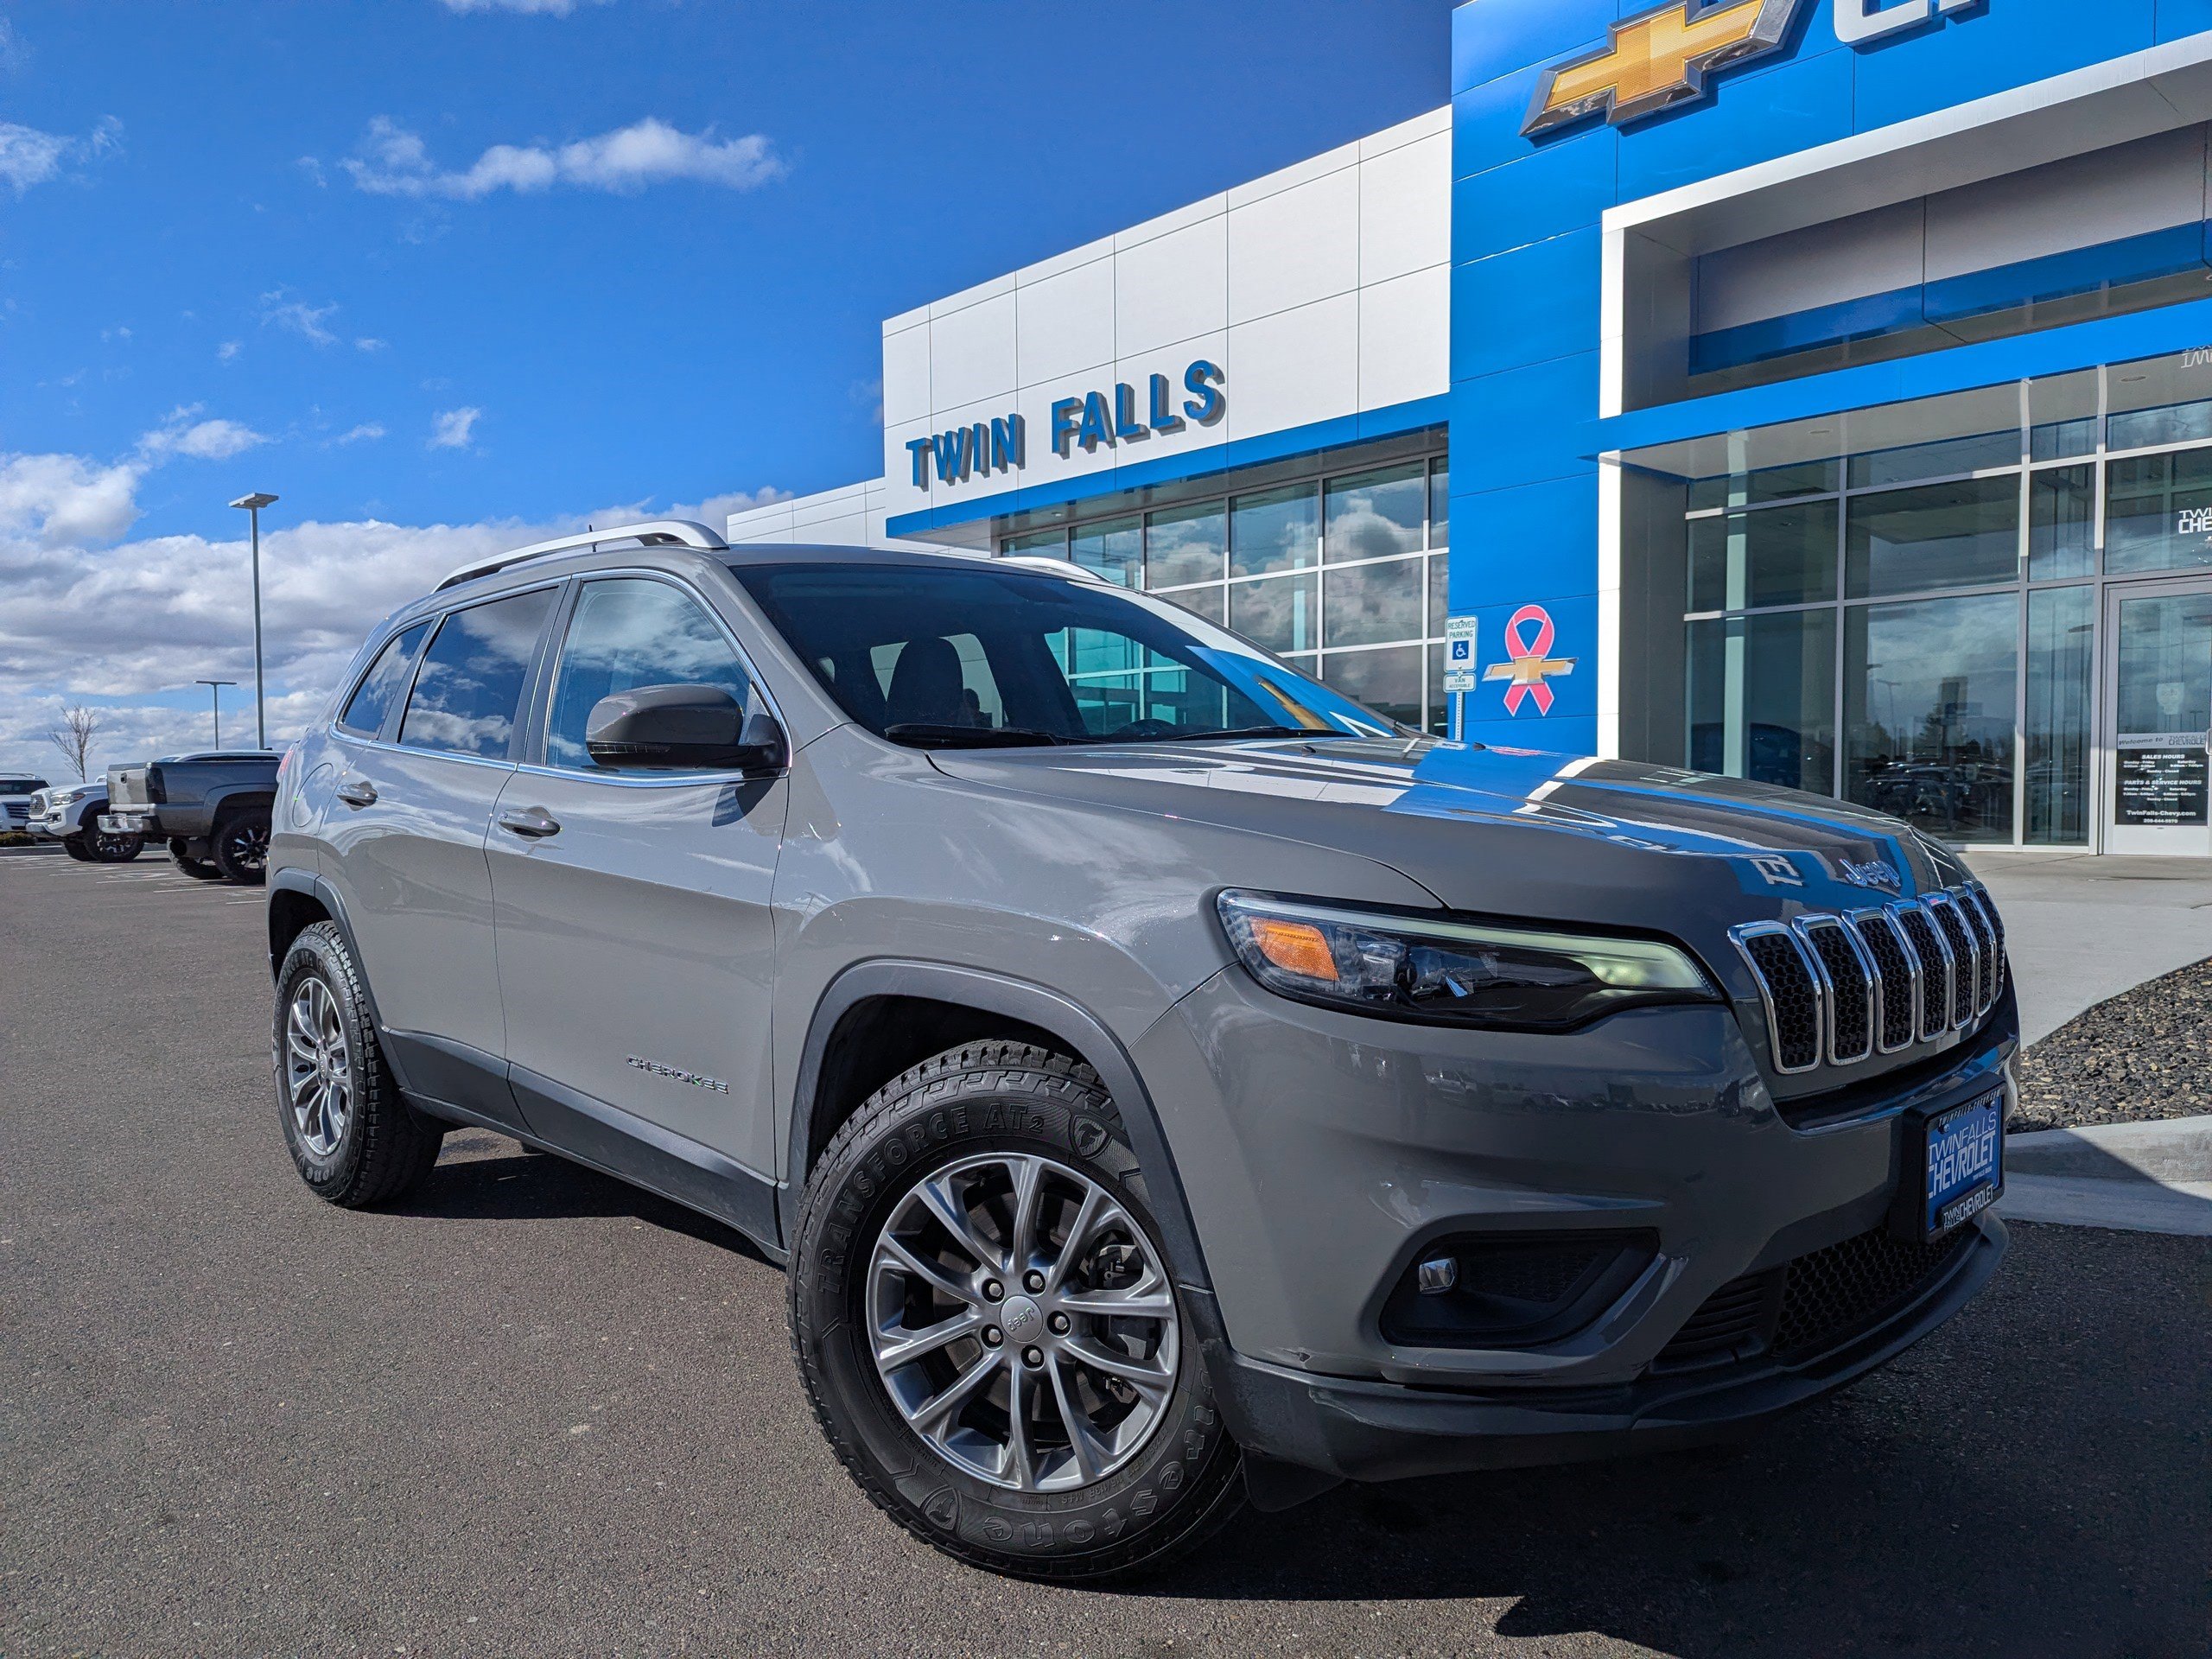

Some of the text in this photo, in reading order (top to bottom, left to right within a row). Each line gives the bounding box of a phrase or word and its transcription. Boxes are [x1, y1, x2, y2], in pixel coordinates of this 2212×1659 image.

[906, 359, 1226, 493] TWIN FALLS
[1447, 620, 1476, 630] RESERVED
[1839, 859, 1902, 887] Jeep
[626, 1054, 728, 1095] CHEROKEE
[1929, 1111, 1998, 1164] TWINFALLS
[818, 1105, 969, 1294] TRANSFORCE
[1959, 1183, 1994, 1222] CHEVROLET
[1007, 1307, 1035, 1332] Jeep
